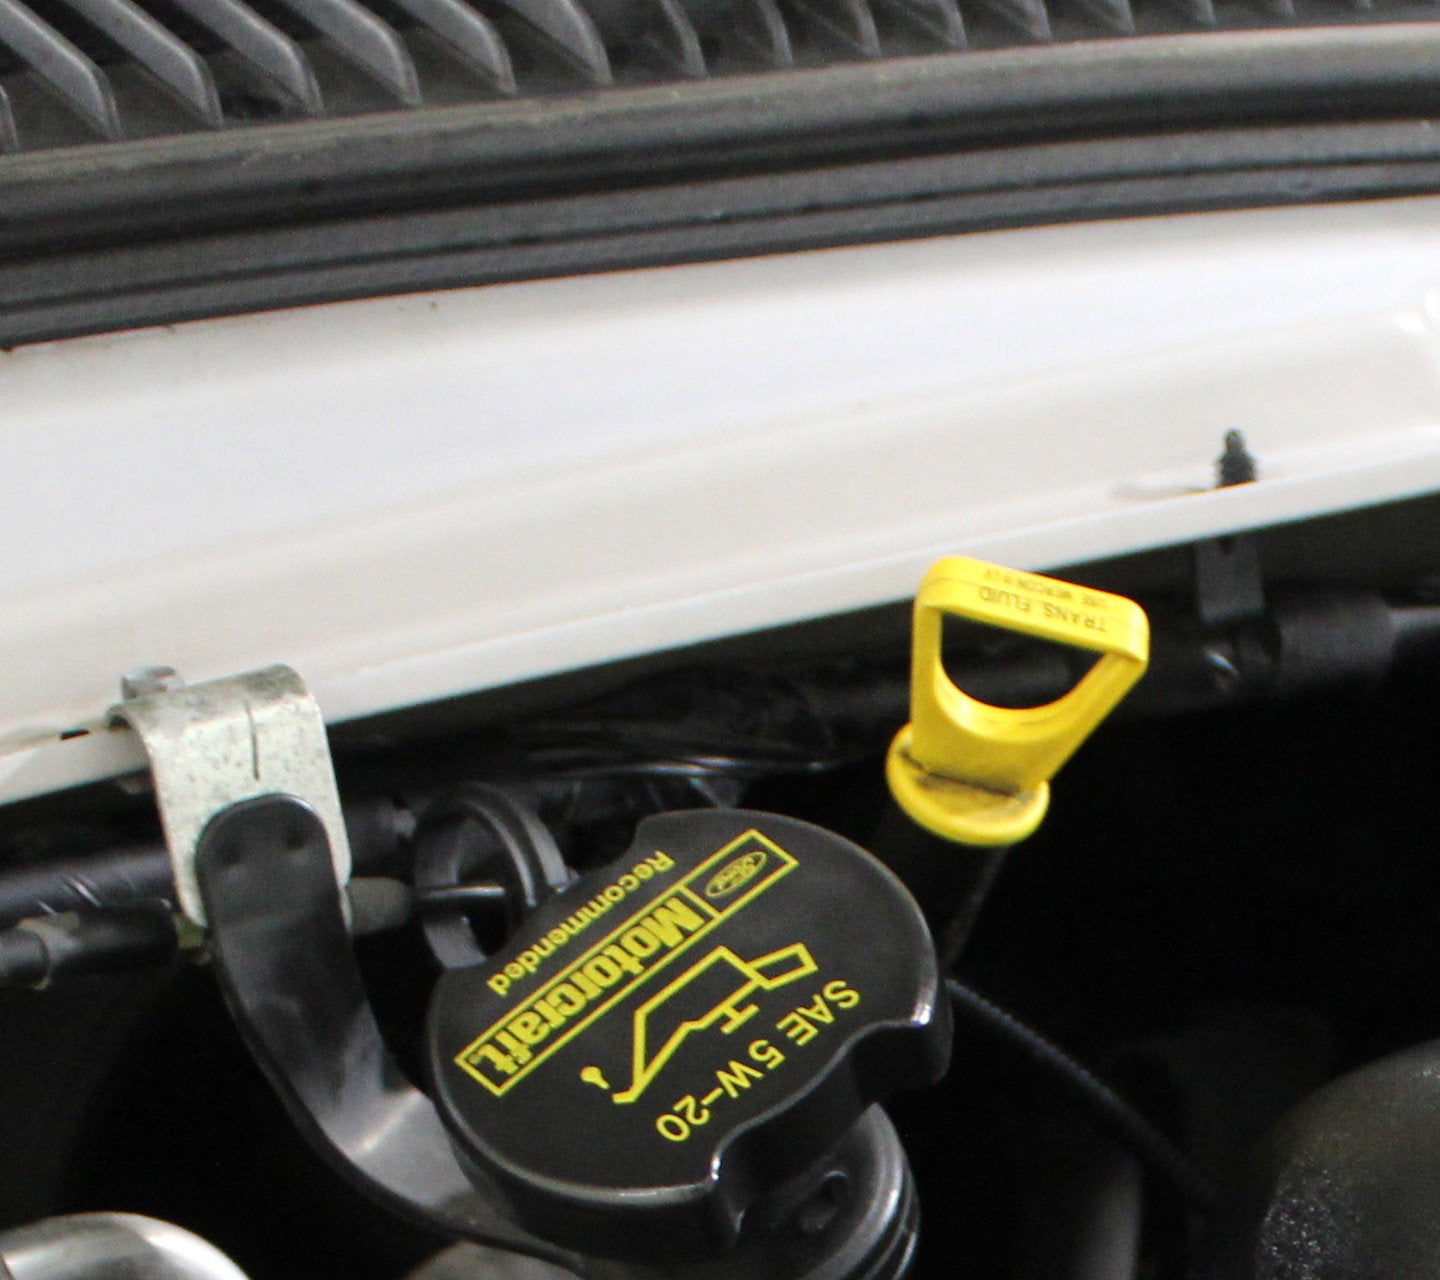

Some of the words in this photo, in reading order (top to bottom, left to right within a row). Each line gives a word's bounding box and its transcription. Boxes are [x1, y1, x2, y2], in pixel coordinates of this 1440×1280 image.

[468, 897, 707, 1076] Motorcraft
[485, 850, 677, 998] Recommended
[774, 978, 862, 1049] SAE
